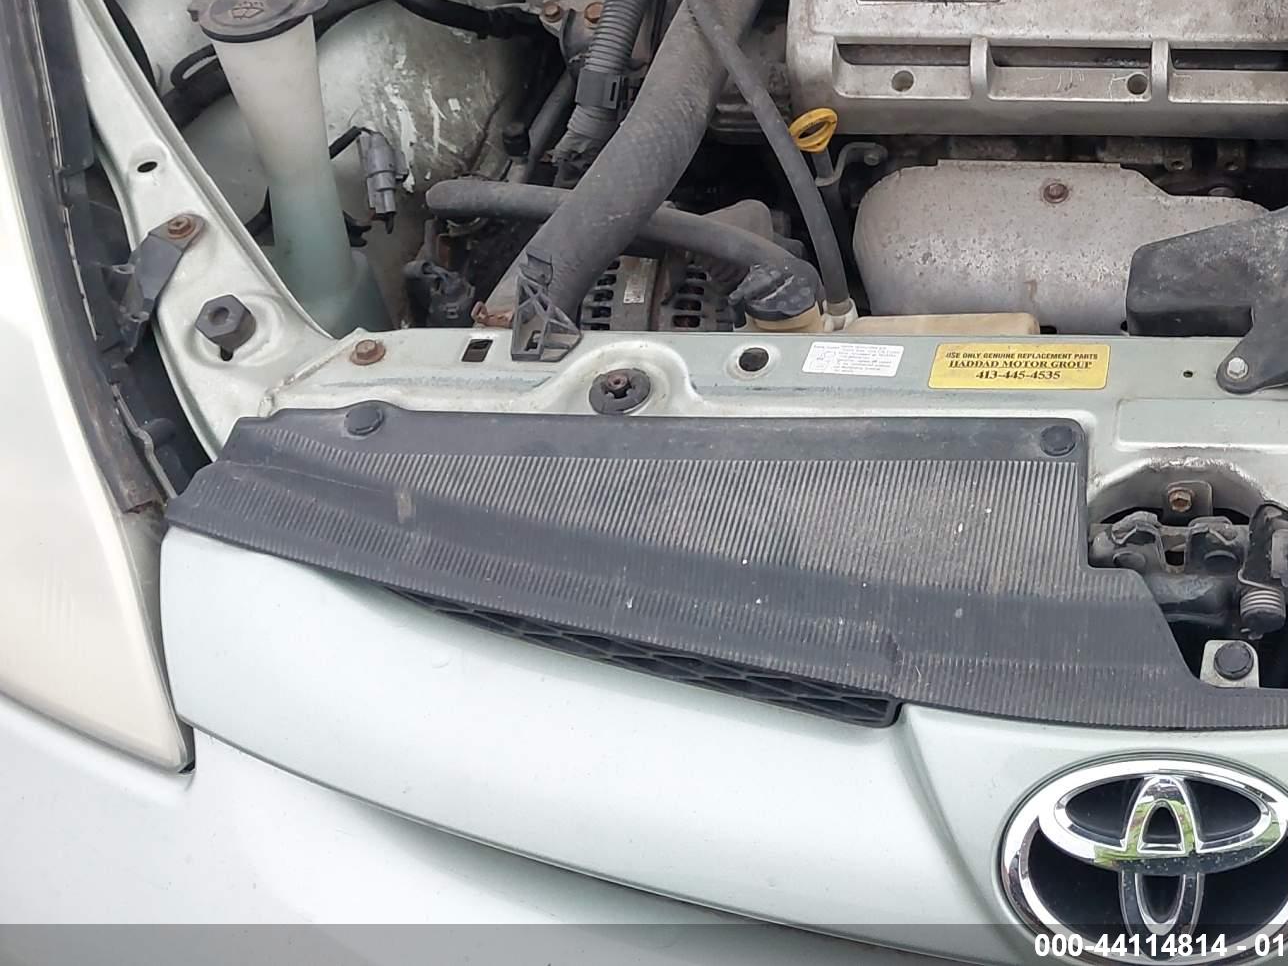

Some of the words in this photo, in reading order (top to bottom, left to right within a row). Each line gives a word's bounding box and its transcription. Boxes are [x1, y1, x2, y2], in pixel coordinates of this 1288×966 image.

[949, 360, 999, 369] HADDAD
[1001, 360, 1047, 369] MOTOR
[1049, 360, 1093, 369] GROUP
[976, 370, 1061, 380] 413-445-4535
